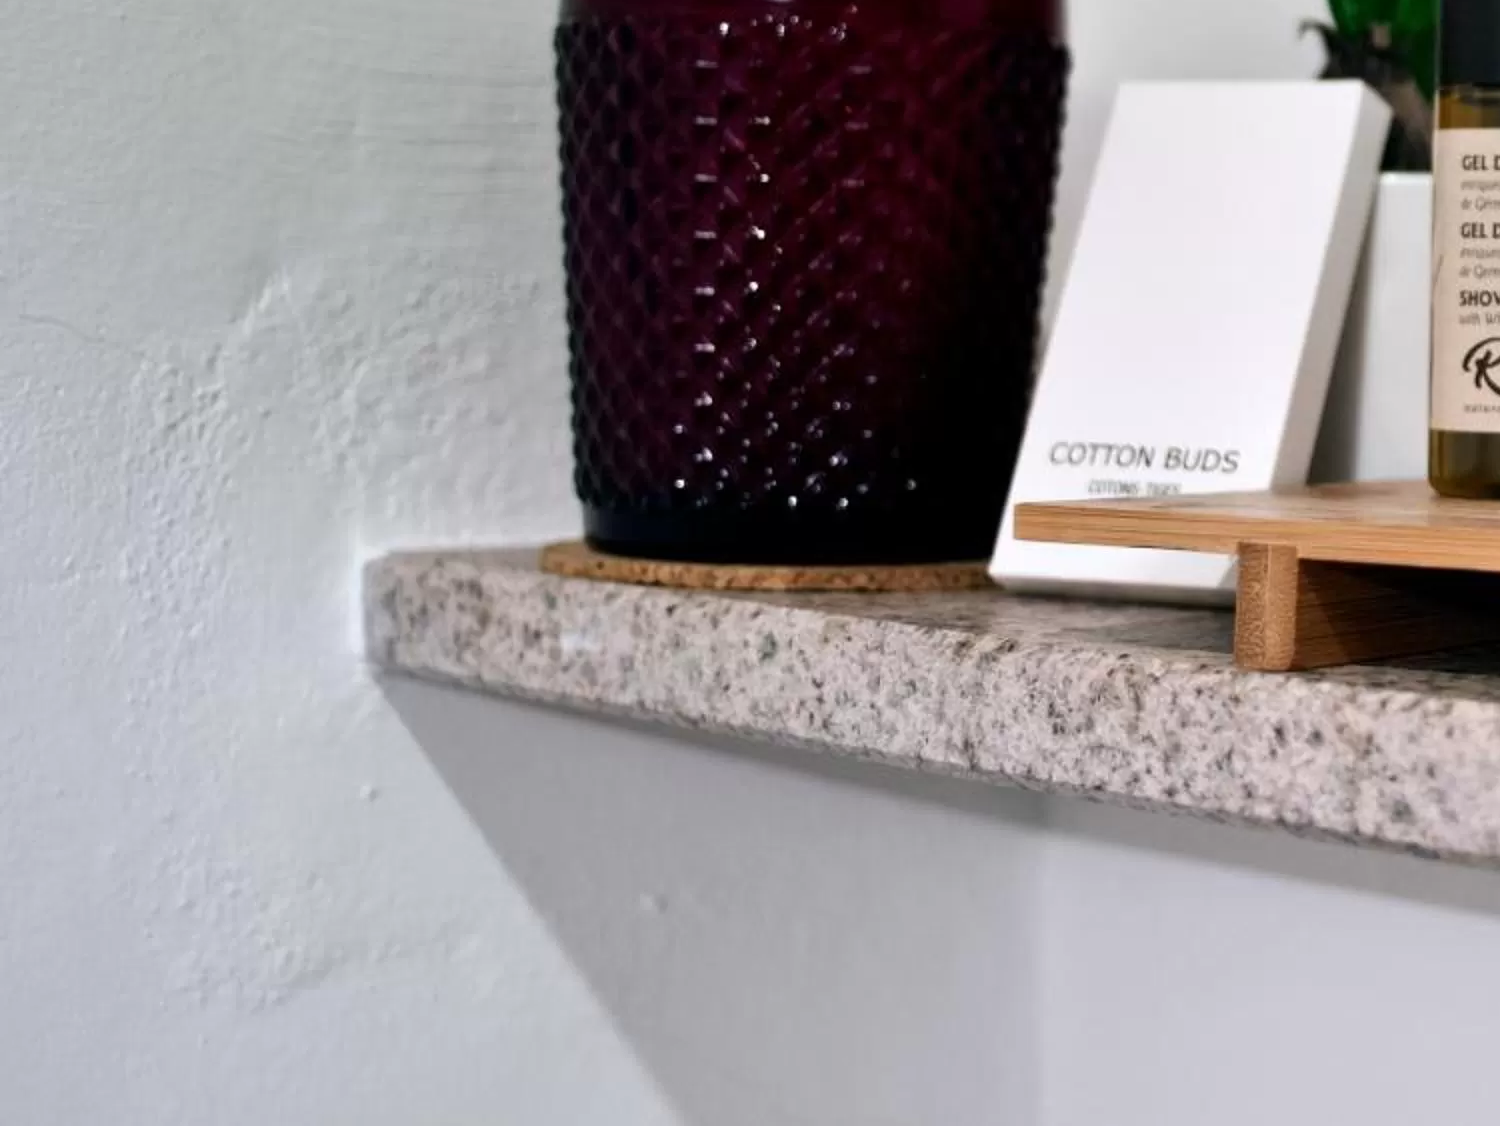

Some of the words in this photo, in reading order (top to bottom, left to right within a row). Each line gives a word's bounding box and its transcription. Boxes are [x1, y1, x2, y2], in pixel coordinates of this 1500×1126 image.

[1462, 154, 1489, 171] GEL
[1461, 222, 1487, 239] GEL
[1049, 441, 1155, 469] COTTON
[1164, 446, 1241, 473] BUDS
